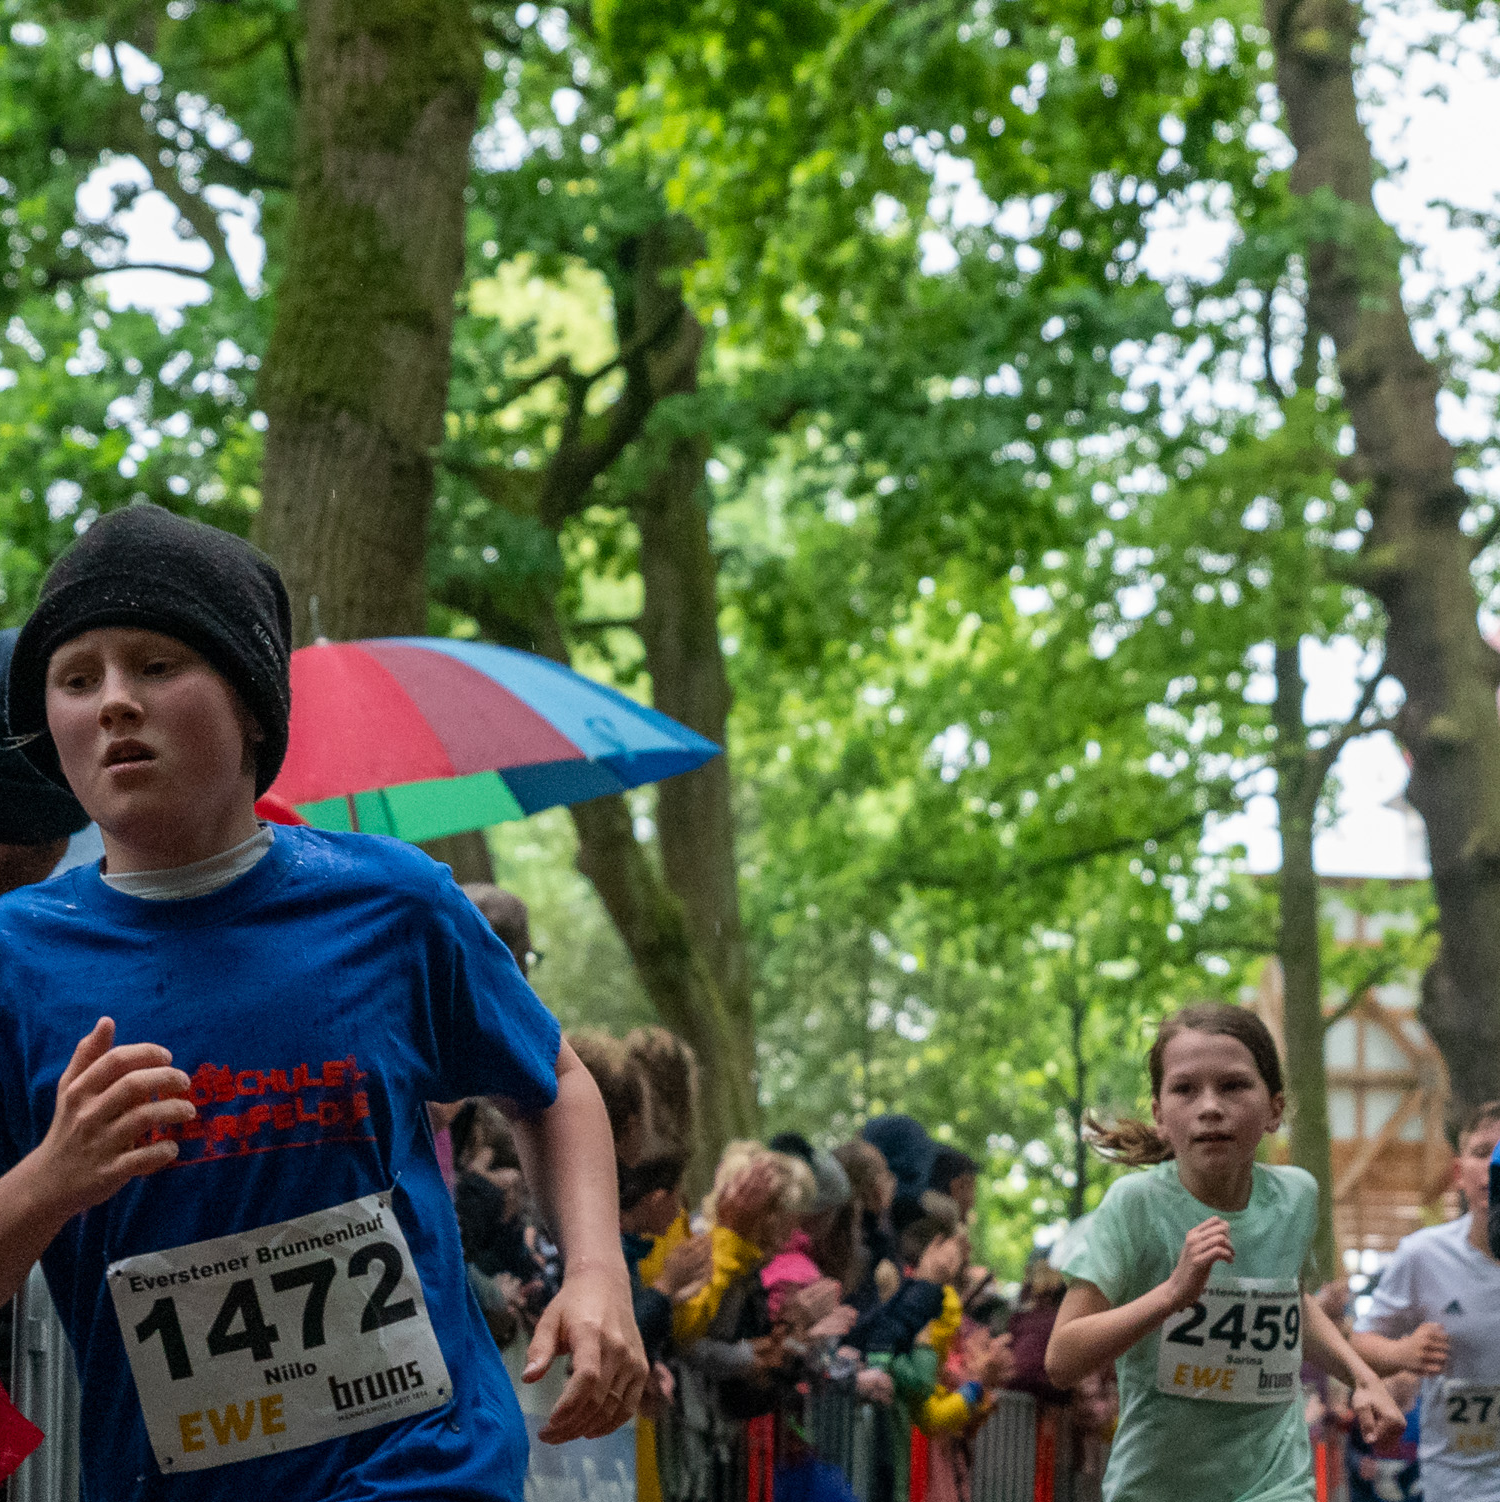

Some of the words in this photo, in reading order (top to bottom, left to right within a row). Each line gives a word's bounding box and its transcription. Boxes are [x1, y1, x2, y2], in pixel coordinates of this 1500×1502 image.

[129, 1254, 250, 1294] Everstener
[256, 1213, 385, 1265] Brunnenlauf
[135, 1241, 418, 1381] 1472
[1166, 1301, 1300, 1351] 2459
[264, 1362, 318, 1386] Niilo
[328, 1360, 425, 1411] bruns
[1173, 1363, 1237, 1391] EWE
[178, 1394, 286, 1453] EWE
